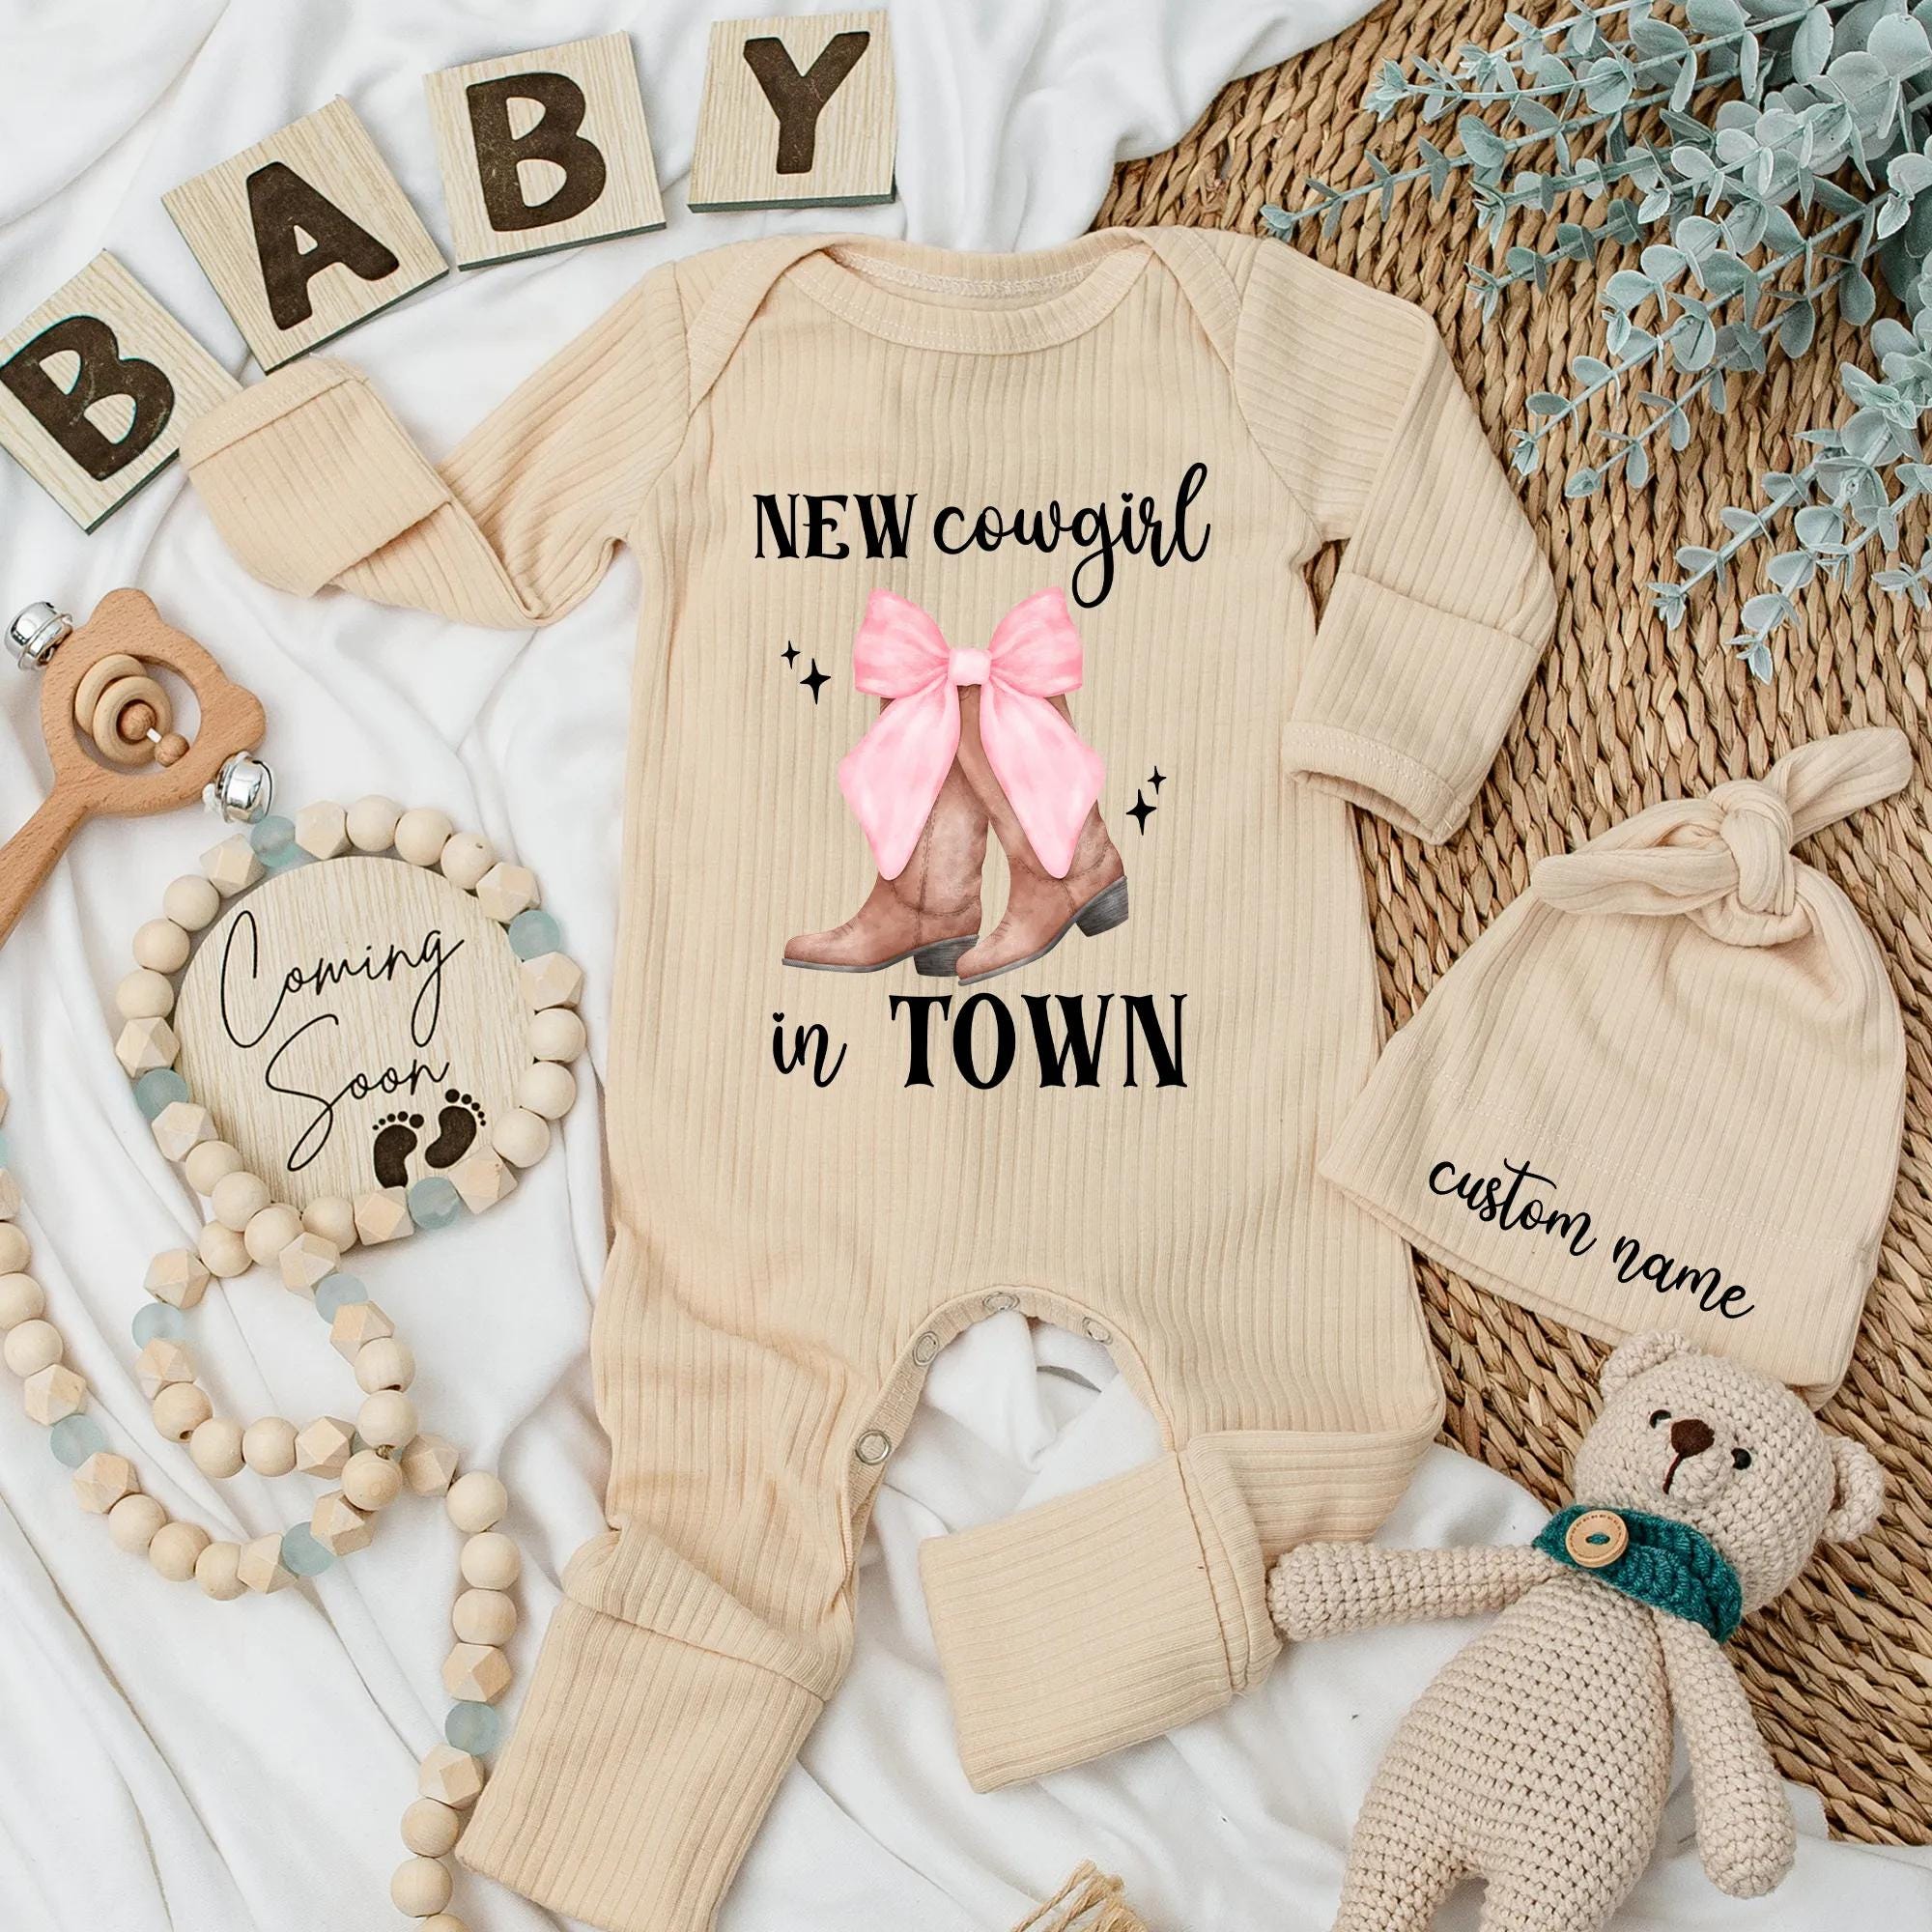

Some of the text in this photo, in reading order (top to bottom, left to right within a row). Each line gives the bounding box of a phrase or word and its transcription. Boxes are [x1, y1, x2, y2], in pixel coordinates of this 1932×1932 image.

[0, 31, 870, 482] BABY
[753, 462, 1211, 610] NEW cowgirl
[220, 910, 466, 1047] Coming
[772, 992, 1188, 1091] in TOWN
[265, 1013, 450, 1172] Soon
[1429, 1157, 1755, 1320] custom name
